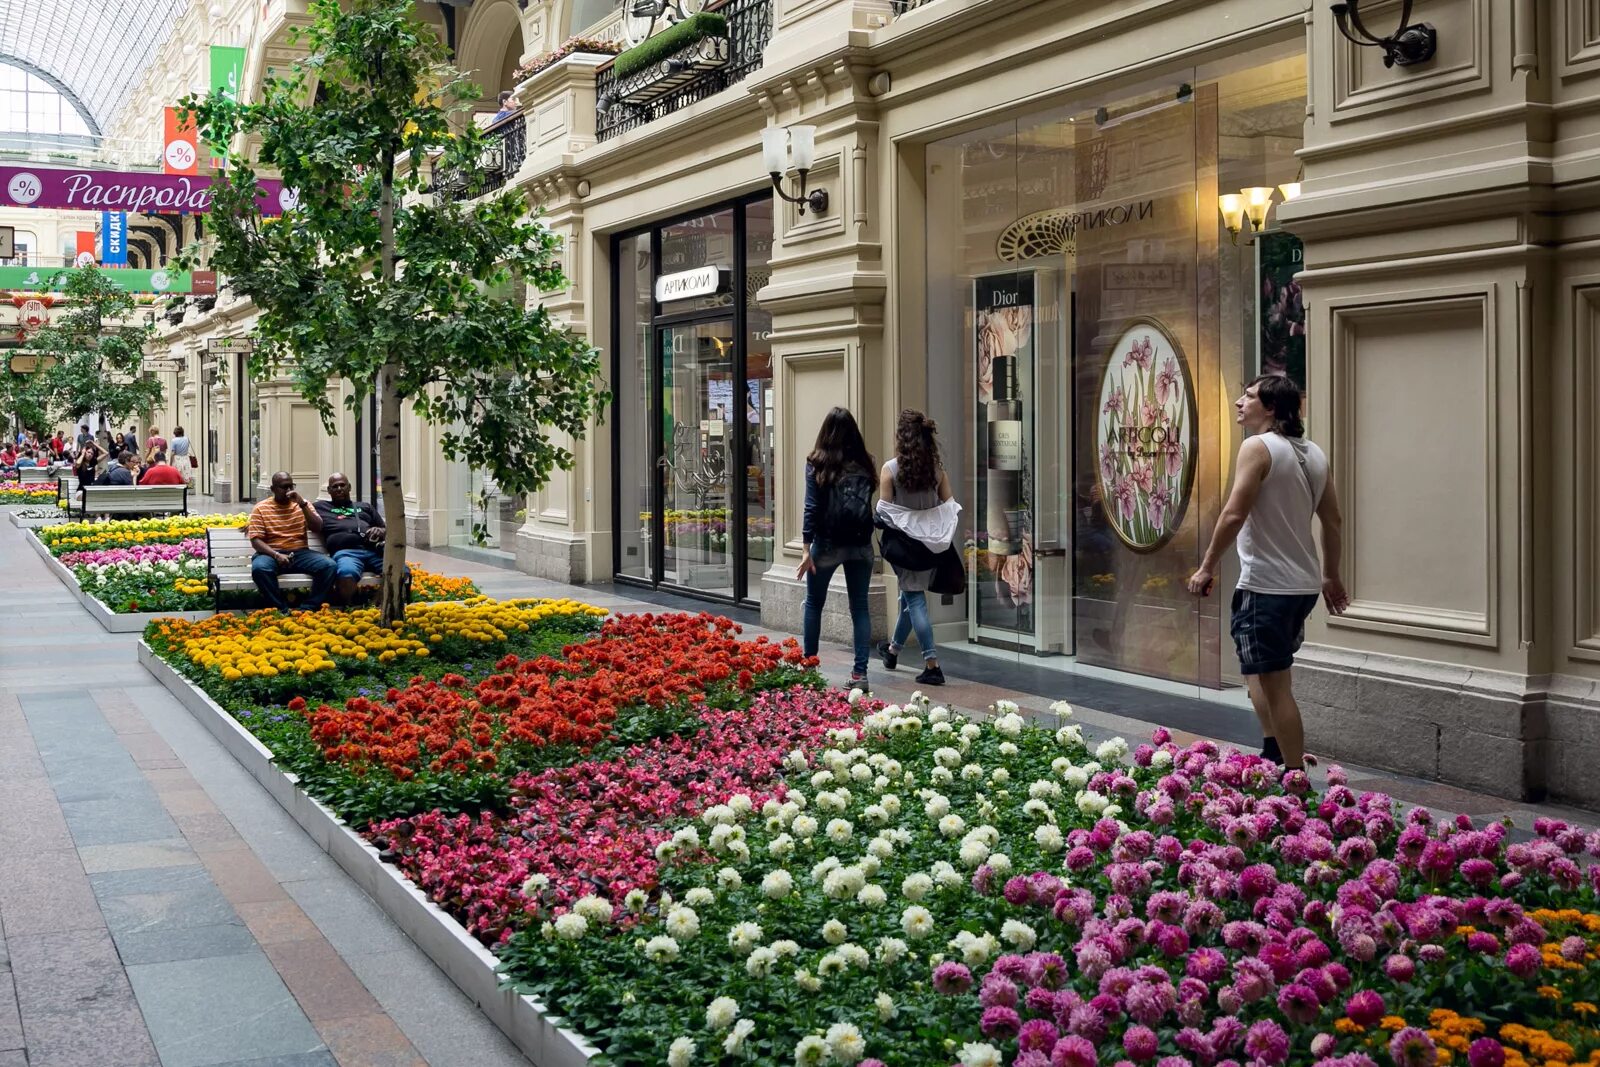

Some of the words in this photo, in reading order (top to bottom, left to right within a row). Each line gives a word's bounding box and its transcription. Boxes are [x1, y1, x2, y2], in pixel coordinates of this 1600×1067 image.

[62, 173, 214, 213] Распрода
[1060, 199, 1153, 232] АРТИКОЛИ
[664, 273, 710, 295] АРТИКОЛИ
[992, 289, 1019, 306] Dior
[1107, 426, 1180, 443] ARTICOLI
